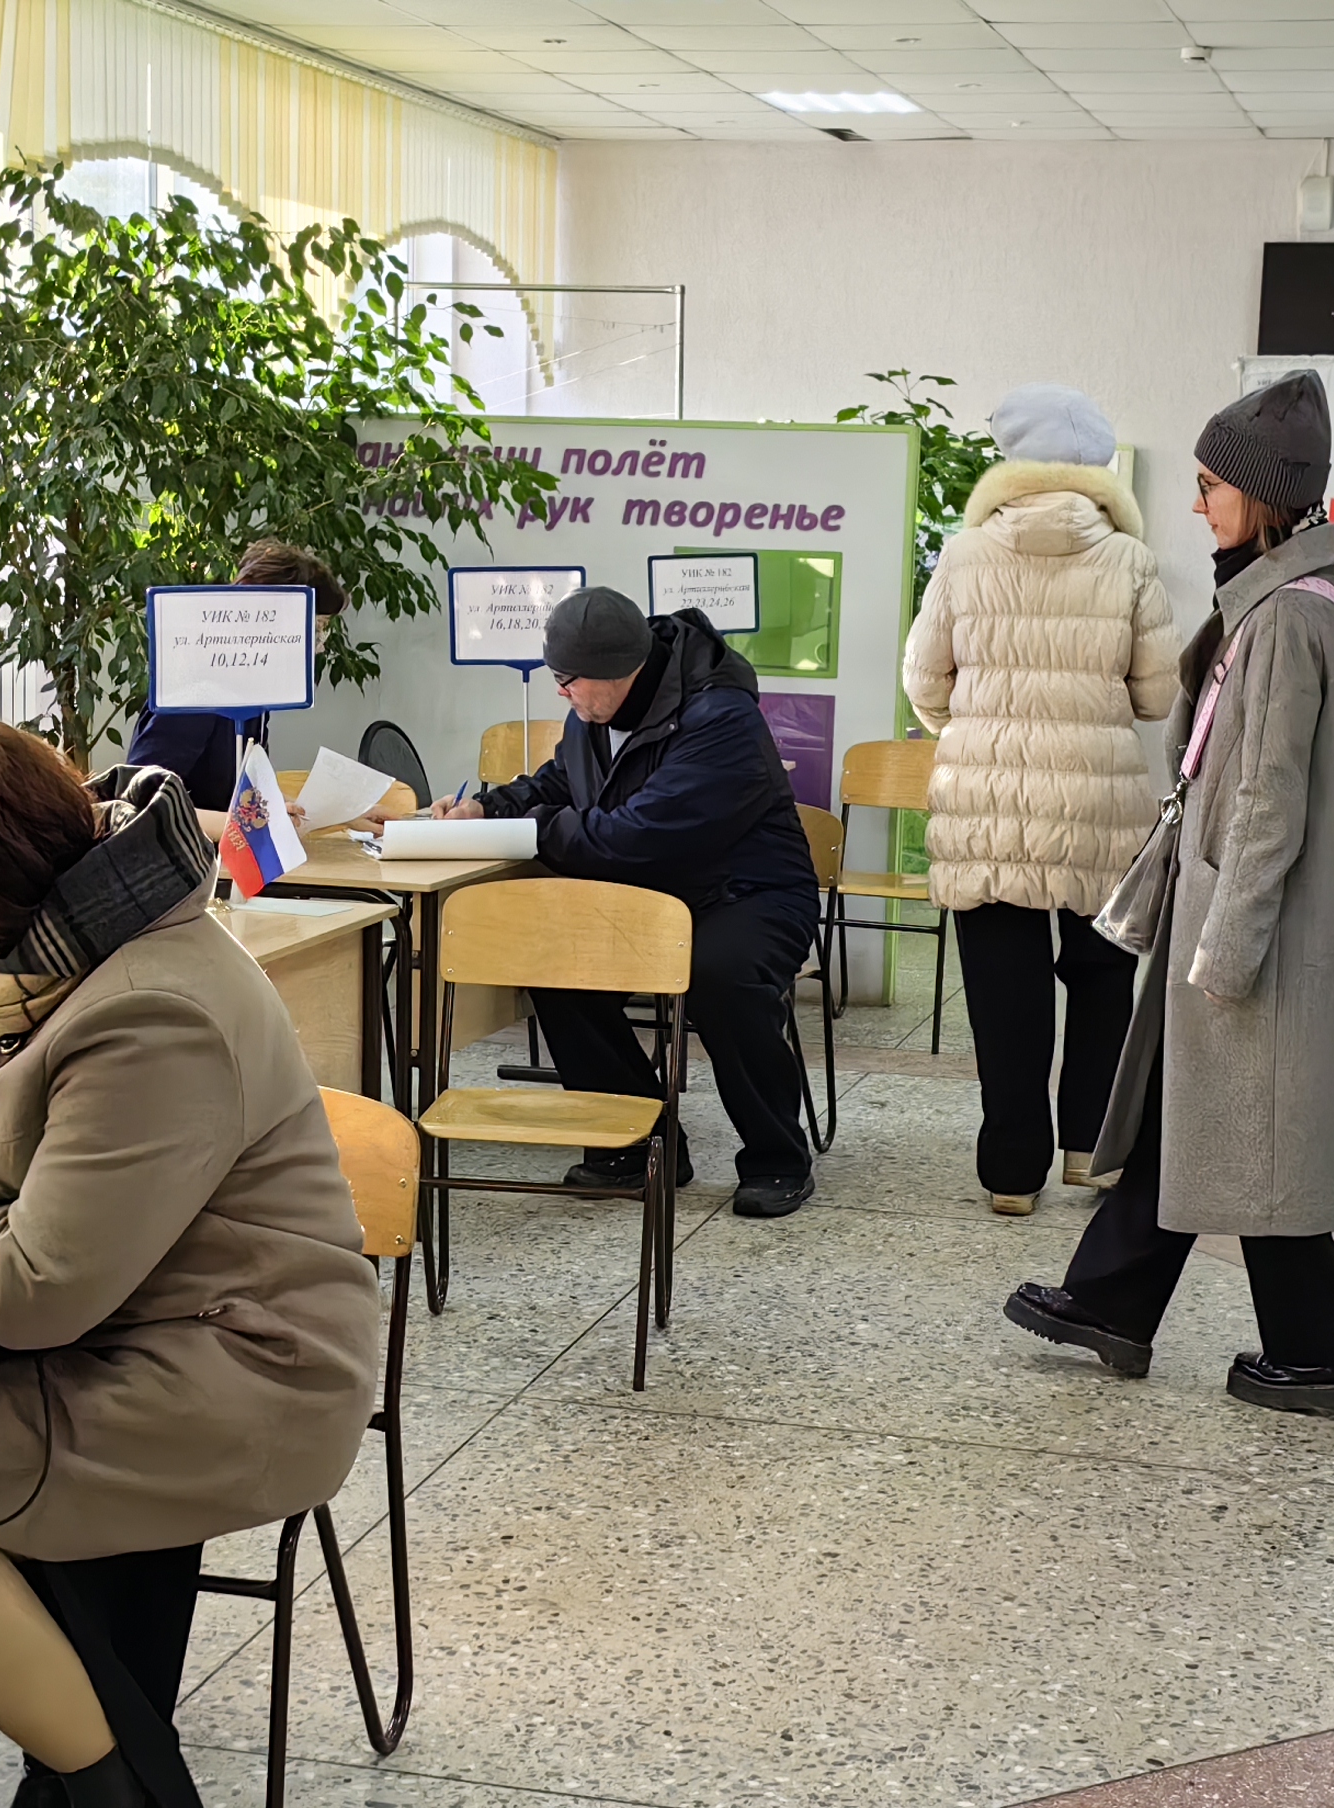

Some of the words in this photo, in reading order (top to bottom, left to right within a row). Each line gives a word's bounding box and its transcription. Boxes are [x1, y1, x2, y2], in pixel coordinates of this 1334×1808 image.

[560, 438, 707, 479] полёт
[621, 498, 846, 538] творенье
[681, 567, 703, 578] УИК
[717, 567, 732, 577] 182
[490, 583, 518, 596] УИК
[680, 597, 736, 609] 22,23,24,26
[201, 609, 233, 623] УИК
[234, 609, 251, 623] №
[254, 609, 278, 623] 182
[172, 635, 191, 650] ул.
[194, 632, 302, 649] Артиллерийская
[209, 652, 270, 668] 10,12,14
